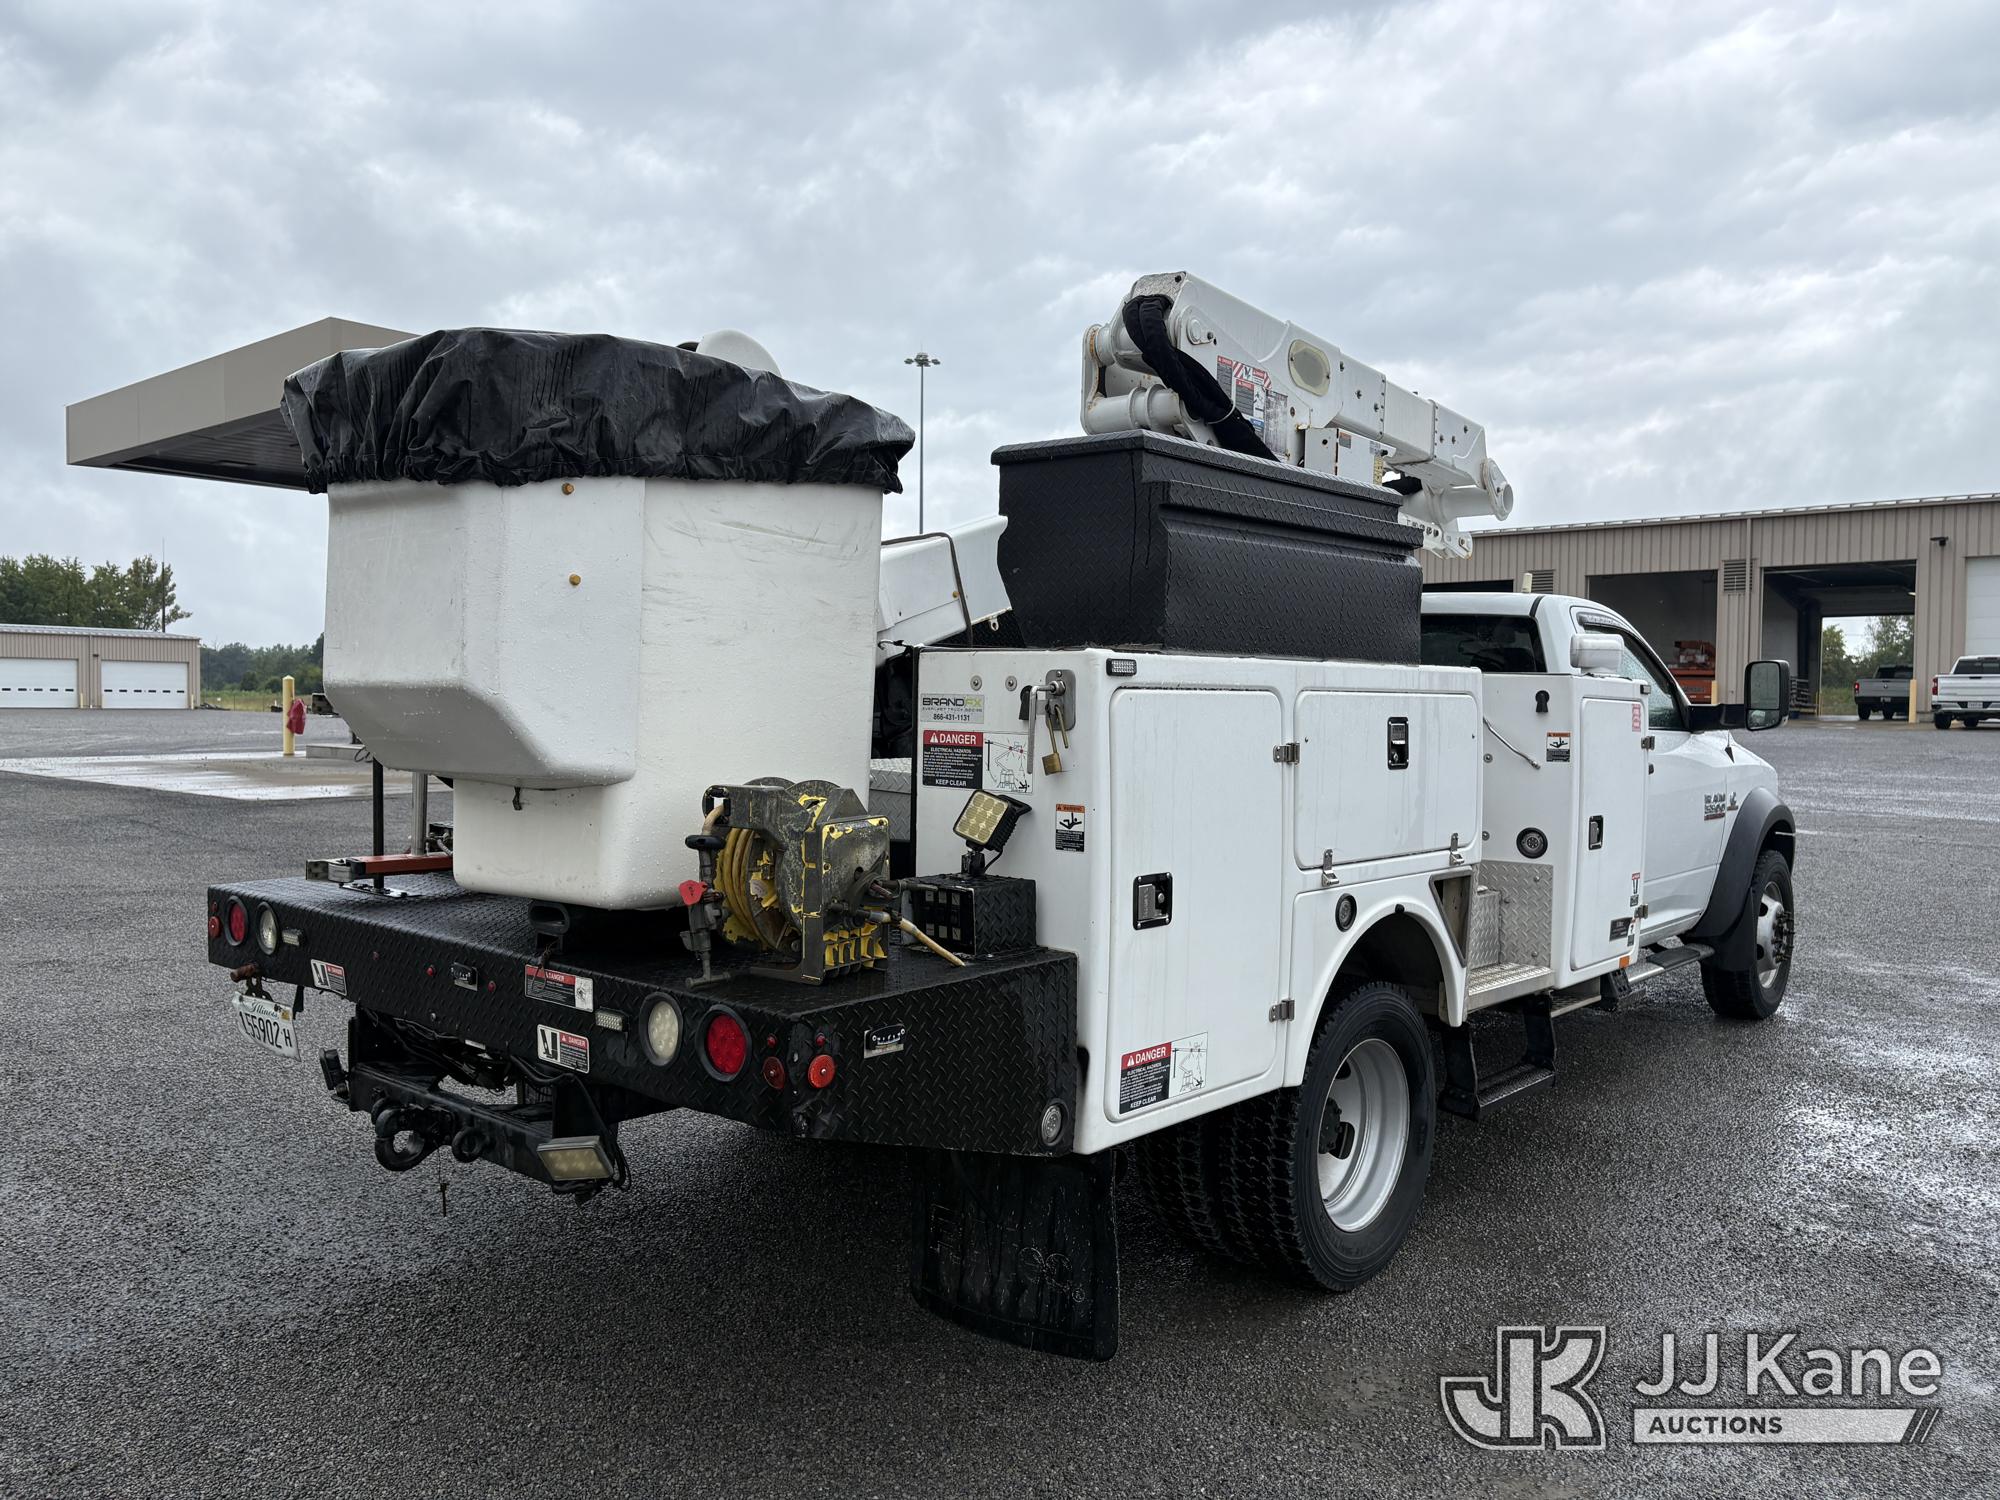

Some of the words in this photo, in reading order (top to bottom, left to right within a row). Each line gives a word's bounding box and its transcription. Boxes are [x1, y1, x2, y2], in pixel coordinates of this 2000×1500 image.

[923, 697, 982, 707] BRANDFX
[933, 713, 970, 721] 866-431-1131
[940, 733, 976, 745] DANGER
[283, 1028, 293, 1048] H
[1135, 1047, 1166, 1064] DANGER
[1130, 1100, 1142, 1108] KEEP
[1142, 1096, 1156, 1105] CLEAR
